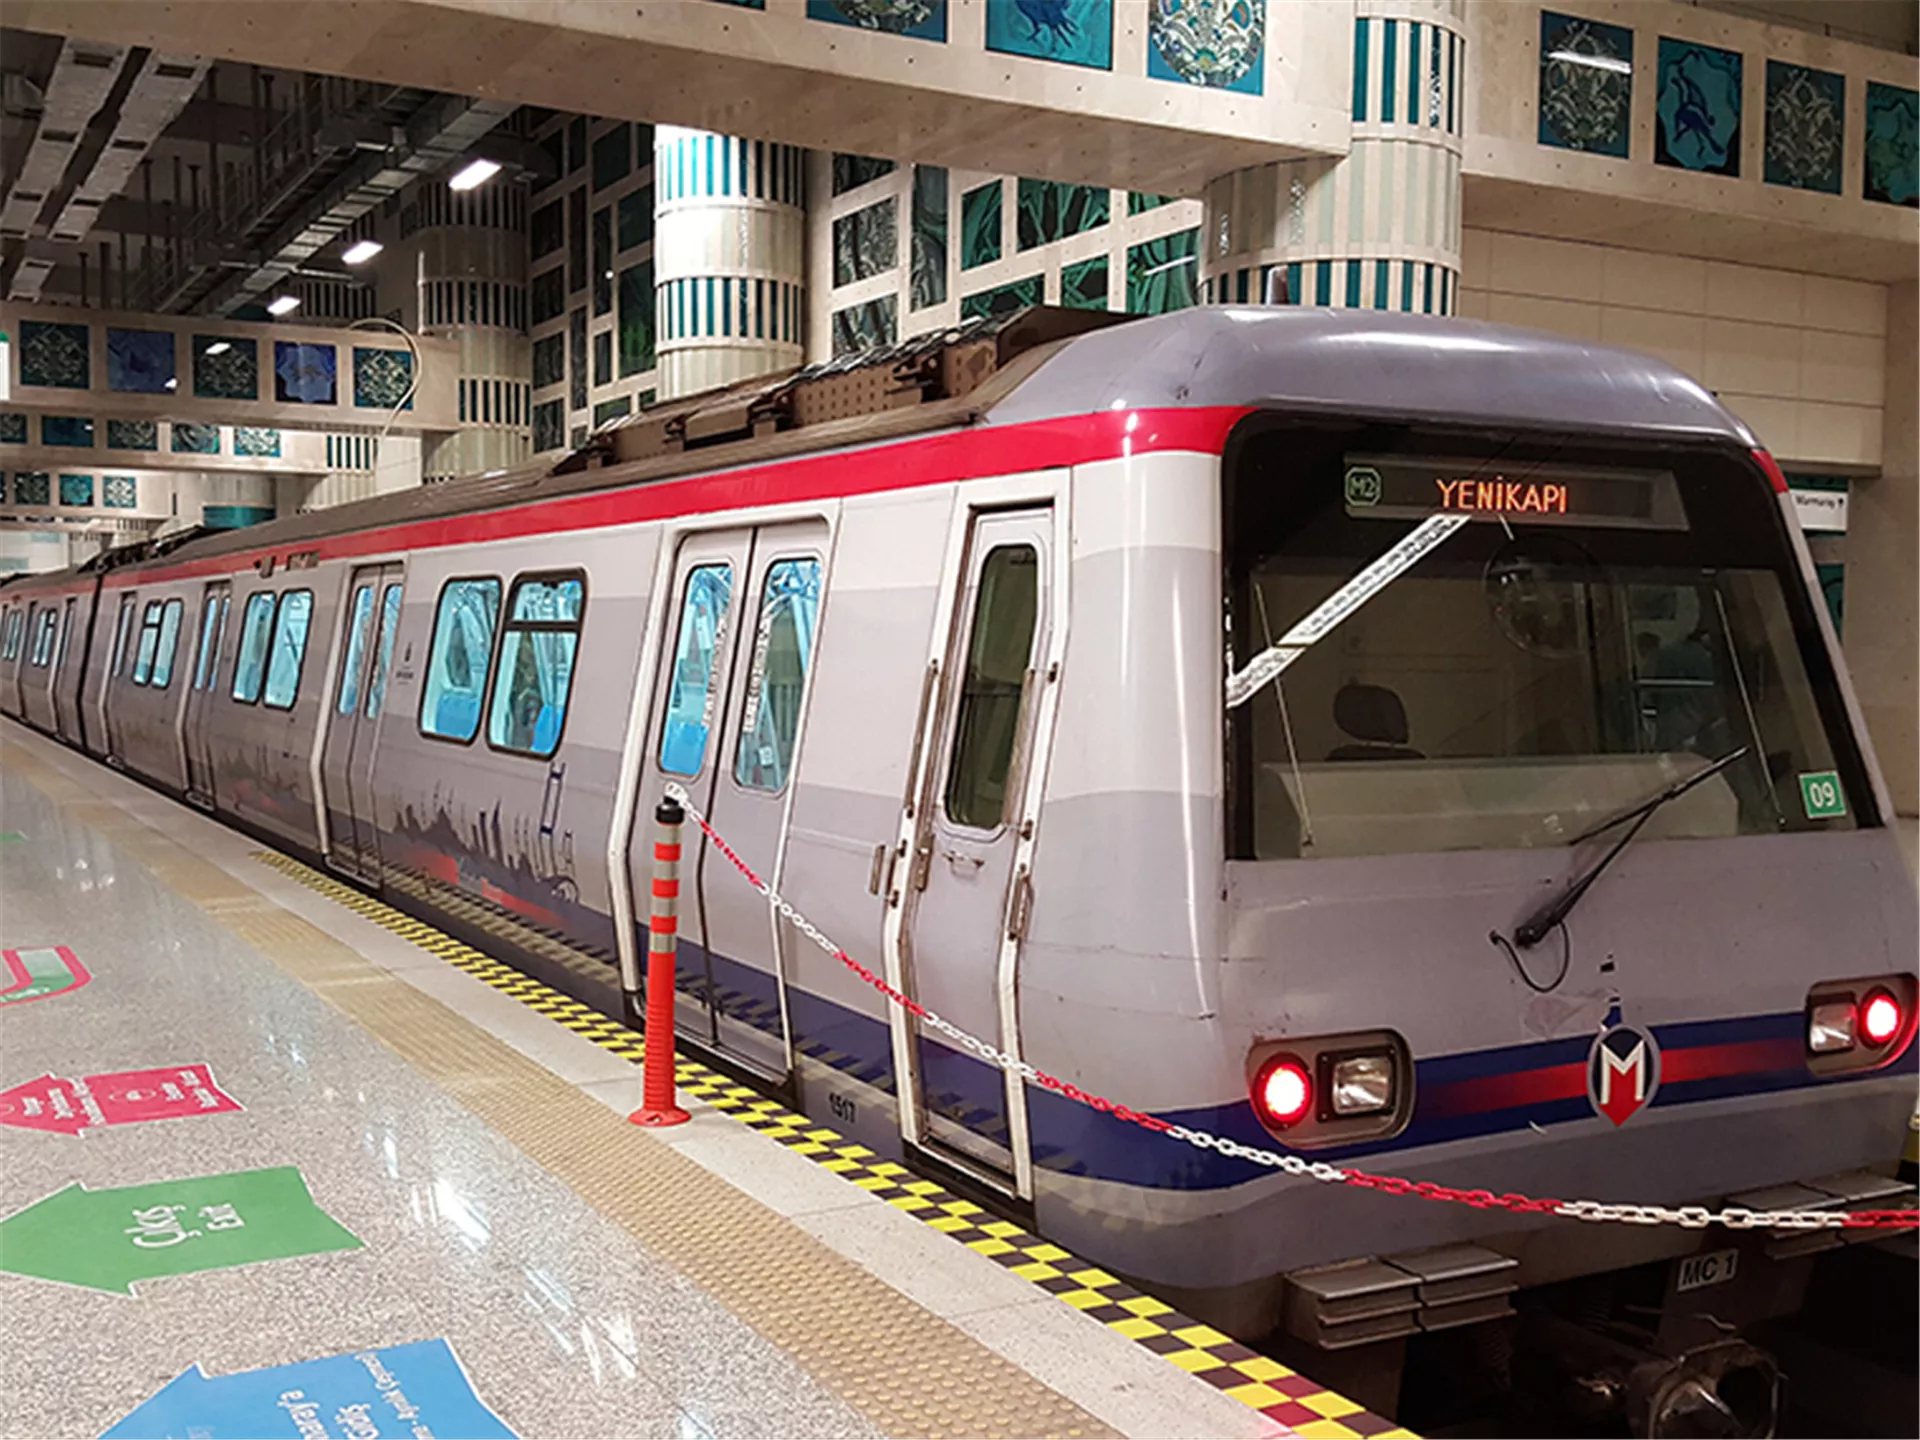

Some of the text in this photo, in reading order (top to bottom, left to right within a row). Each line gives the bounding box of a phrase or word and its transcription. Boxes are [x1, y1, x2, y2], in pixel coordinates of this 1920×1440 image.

[1350, 476, 1376, 497] M2
[1435, 476, 1566, 514] YENİKAPI
[1810, 782, 1836, 808] 09
[829, 1092, 856, 1122] 1517
[1682, 1253, 1735, 1286] MC 1
